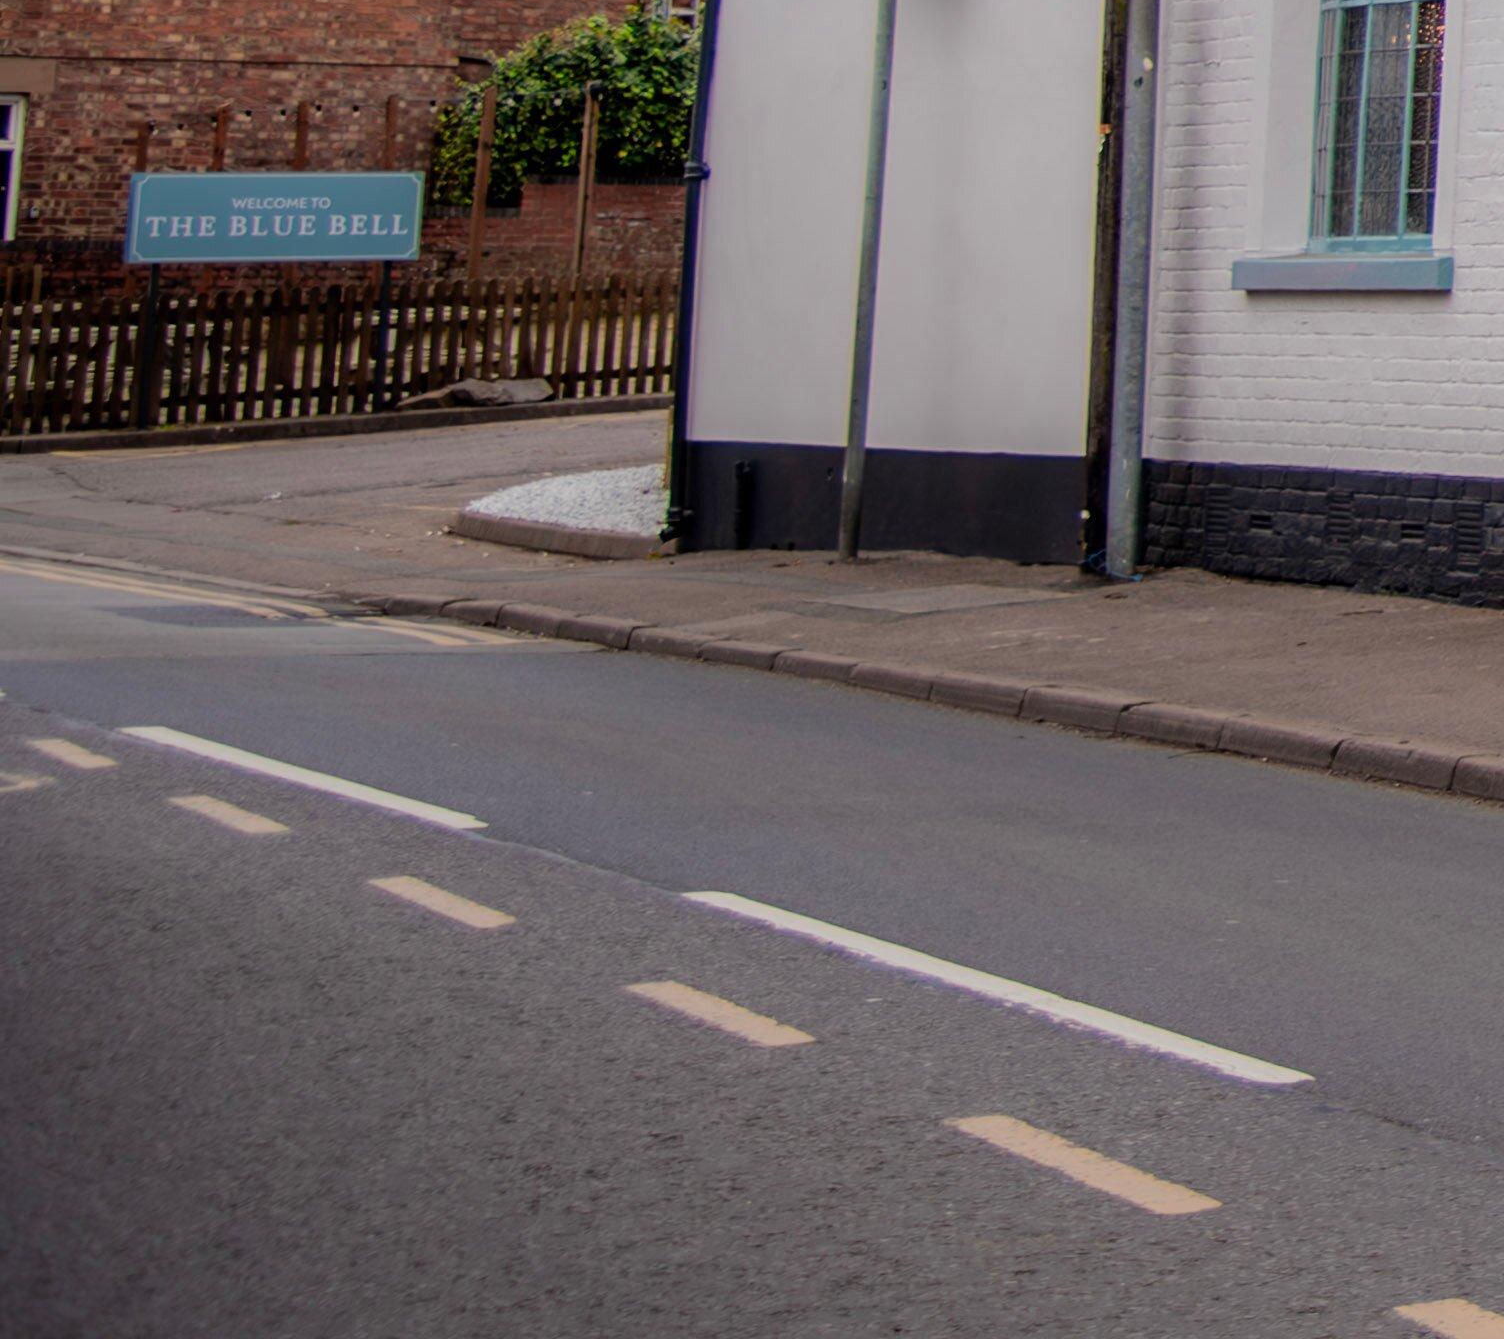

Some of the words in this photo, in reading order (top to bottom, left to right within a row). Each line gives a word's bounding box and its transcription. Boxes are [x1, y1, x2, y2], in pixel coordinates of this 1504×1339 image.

[232, 197, 307, 210] WELCOME
[309, 197, 332, 210] TO
[145, 215, 216, 238] THE
[228, 214, 316, 237] BLUE
[328, 214, 409, 236] BELL
